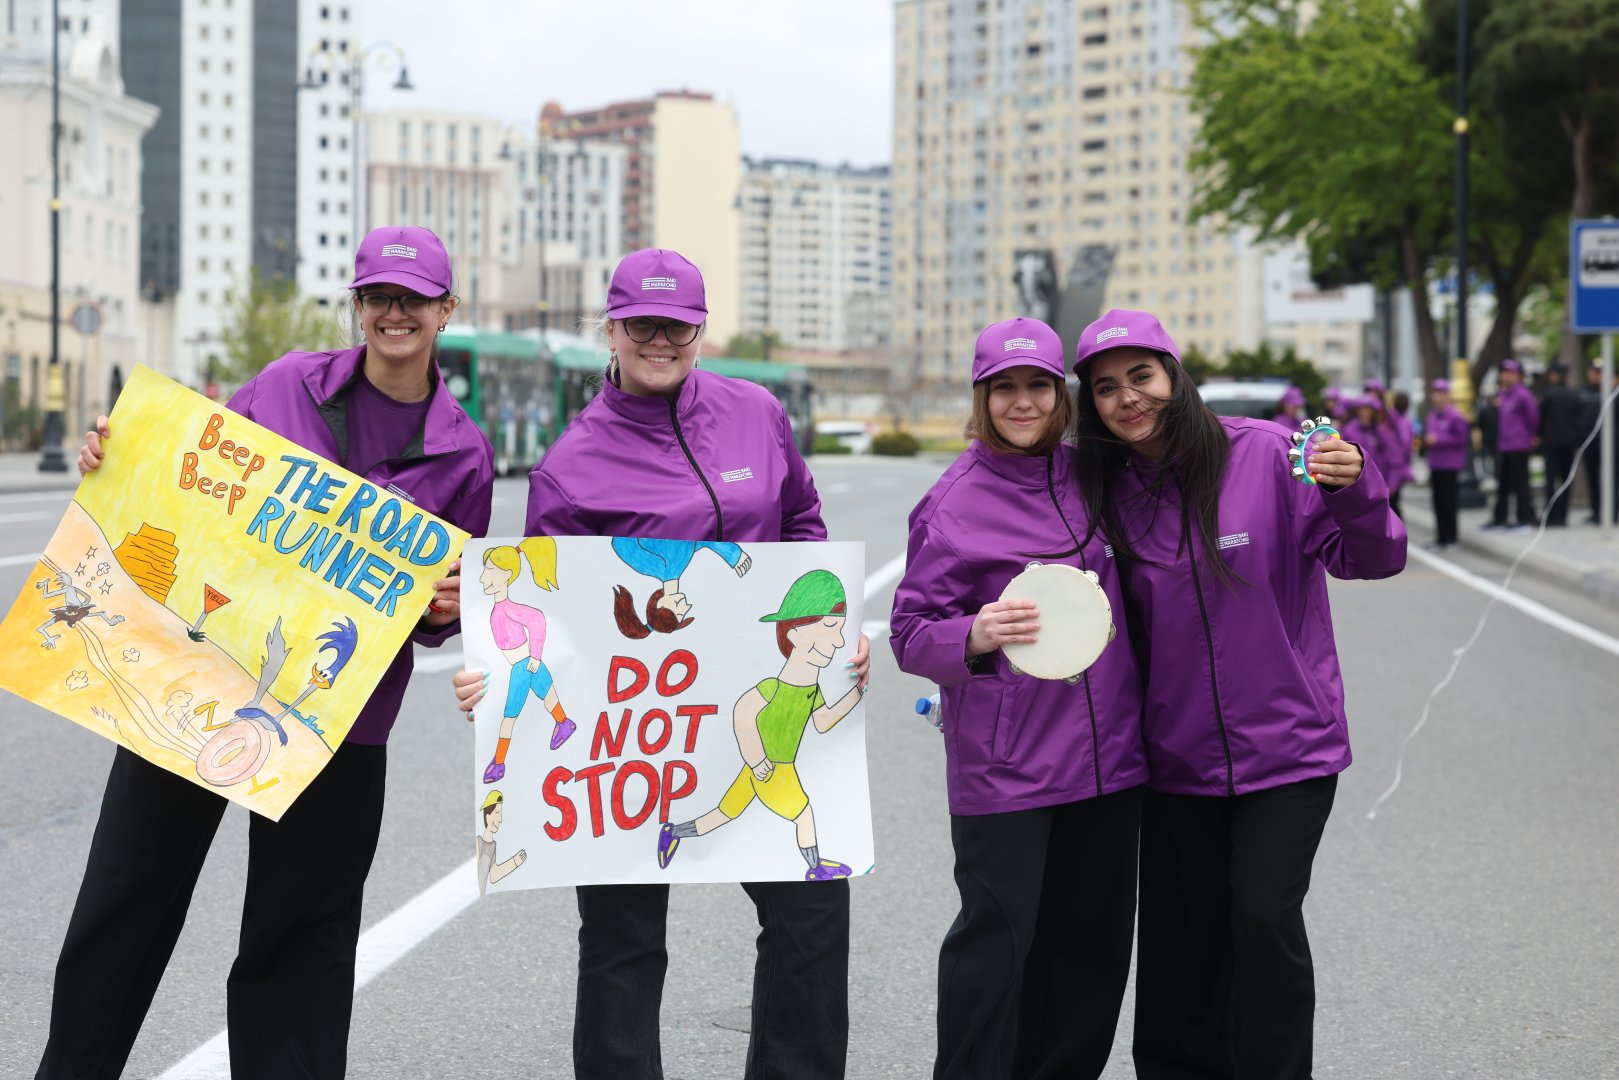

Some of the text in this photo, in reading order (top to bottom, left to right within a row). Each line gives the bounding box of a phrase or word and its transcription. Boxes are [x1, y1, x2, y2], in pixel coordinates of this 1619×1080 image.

[198, 413, 265, 482] Beep
[179, 452, 246, 515] Beep
[274, 455, 450, 566] THE ROAD
[246, 496, 414, 617] RUNNER
[207, 590, 225, 605] YIELD
[607, 649, 699, 704] DO
[590, 705, 718, 761] NOT
[542, 760, 698, 842] STOP
